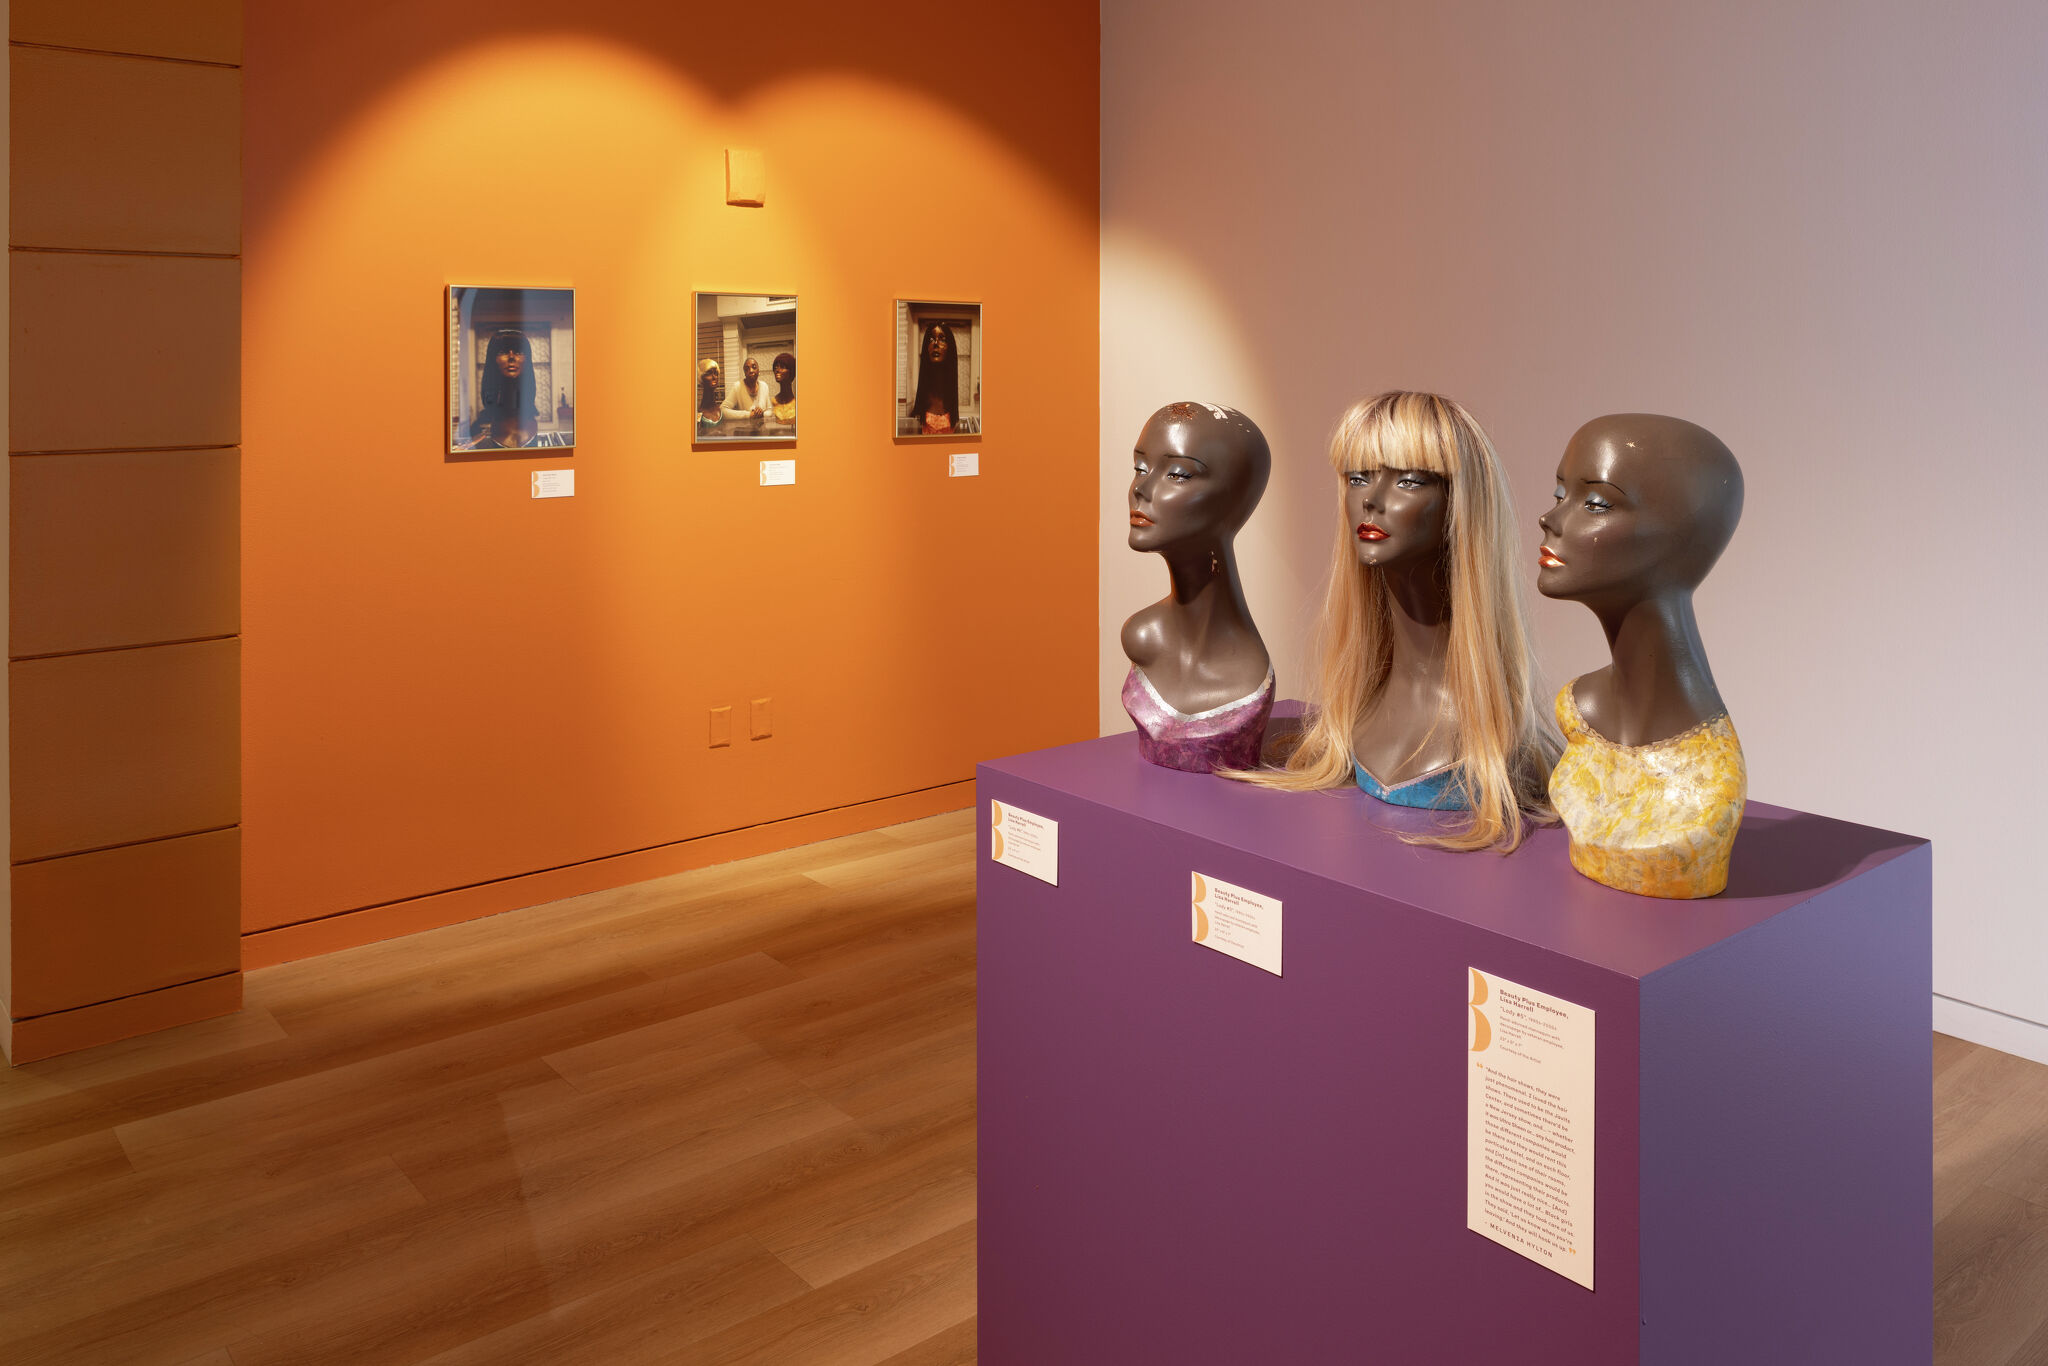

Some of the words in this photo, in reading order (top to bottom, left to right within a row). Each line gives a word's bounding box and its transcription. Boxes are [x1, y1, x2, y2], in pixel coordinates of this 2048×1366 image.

[1215, 888, 1229, 898] Beauty
[1500, 989, 1520, 1002] Beauty
[1522, 997, 1535, 1006] Plus
[1537, 1002, 1568, 1019] Employee,
[1500, 996, 1512, 1004] Lisa
[1514, 1001, 1533, 1012] Harrell
[1503, 1092, 1516, 1101] There
[1518, 1099, 1530, 1107] used
[1507, 1075, 1517, 1084] hair
[1518, 1081, 1534, 1092] shows,
[1536, 1087, 1546, 1097] they
[1548, 1093, 1560, 1101] were
[1486, 1093, 1502, 1106] Center,
[1514, 1106, 1541, 1121] sometimes
[1542, 1117, 1560, 1129] there'd
[1533, 1095, 1546, 1104] loved
[1558, 1105, 1567, 1113] hair
[1490, 1104, 1499, 1112] New
[1501, 1109, 1516, 1121] Jersey
[1518, 1117, 1532, 1127] show,
[1553, 1132, 1573, 1143] whether
[1512, 1122, 1526, 1132] Sheen
[1545, 1136, 1554, 1145] hair
[1492, 1132, 1505, 1141] there
[1517, 1142, 1527, 1152] they
[1529, 1149, 1544, 1158] would
[1557, 1160, 1566, 1169] this
[1500, 1126, 1521, 1140] different
[1523, 1137, 1549, 1152] companies
[1551, 1149, 1566, 1159] would
[1485, 1138, 1509, 1152] particular
[1511, 1149, 1524, 1160] hotel,
[1544, 1164, 1556, 1173] each
[1557, 1170, 1571, 1181] floor,
[1495, 1151, 1504, 1160] [in]
[1506, 1156, 1517, 1165] each
[1535, 1169, 1547, 1178] their
[1485, 1173, 1494, 1181] And
[1522, 1191, 1536, 1202] really
[1494, 1159, 1515, 1173] different
[1517, 1170, 1544, 1186] companies
[1545, 1183, 1560, 1193] would
[1501, 1172, 1532, 1191] representing
[1533, 1186, 1545, 1196] their
[1495, 1187, 1509, 1197] would
[1510, 1194, 1522, 1203] have
[1545, 1210, 1559, 1221] Black
[1561, 1218, 1572, 1227] girls
[1500, 1198, 1512, 1208] show
[1524, 1209, 1534, 1219] they
[1536, 1215, 1547, 1224] took
[1549, 1222, 1559, 1230] care
[1485, 1200, 1496, 1210] They
[1528, 1220, 1540, 1230] know
[1542, 1228, 1555, 1238] when
[1557, 1235, 1572, 1246] you're
[1506, 1218, 1515, 1227] And
[1517, 1224, 1526, 1234] they
[1539, 1234, 1550, 1244] hook
[1490, 1223, 1524, 1244] MELVENIA
[1527, 1241, 1552, 1258] HYLTON
